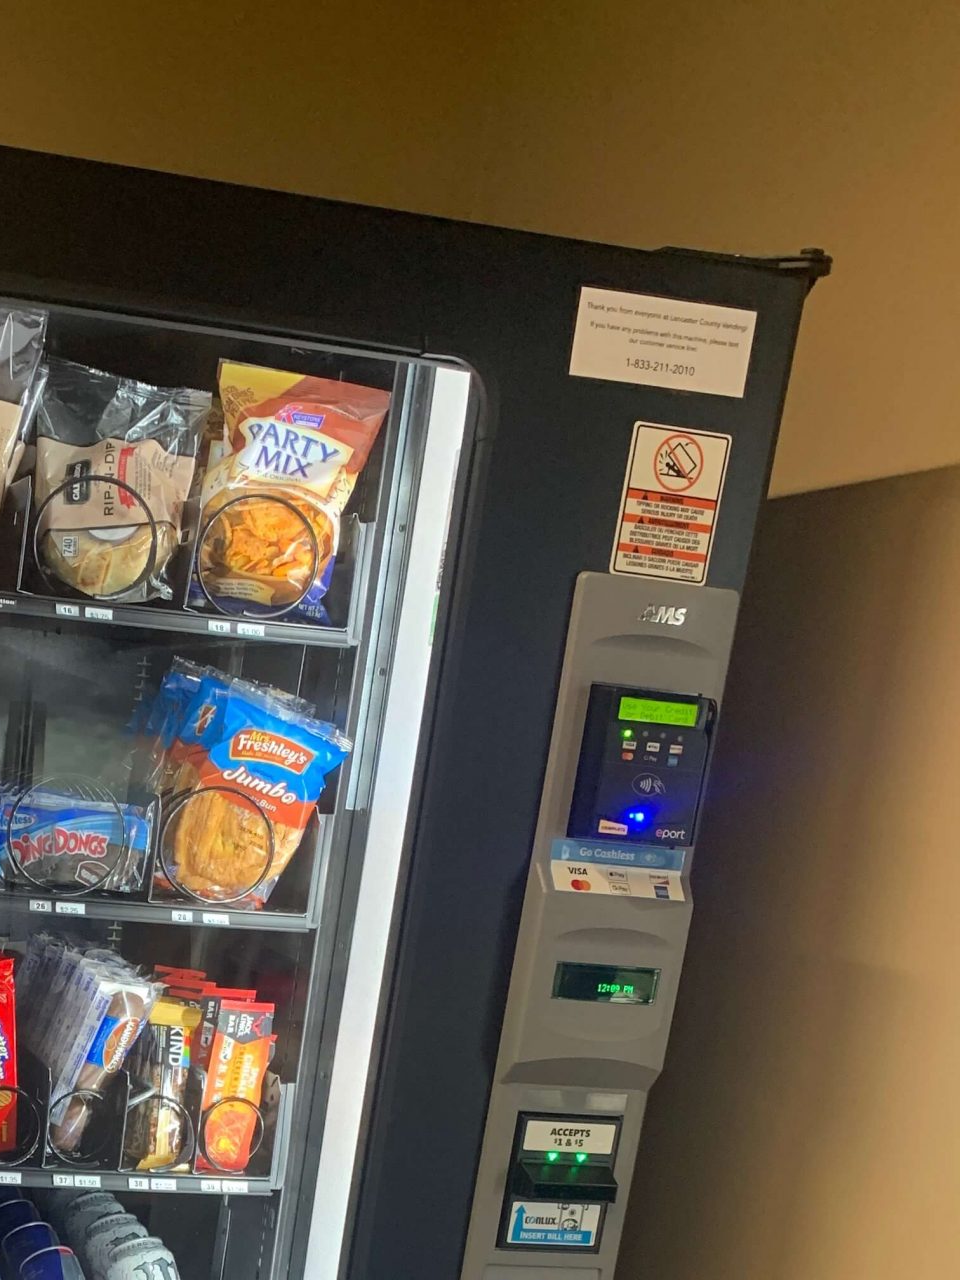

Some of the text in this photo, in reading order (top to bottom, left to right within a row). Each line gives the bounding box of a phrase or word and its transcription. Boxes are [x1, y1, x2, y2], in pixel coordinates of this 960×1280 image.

[588, 301, 604, 311] Thank
[606, 305, 617, 314] you
[619, 306, 634, 315] from
[700, 318, 721, 329] County
[607, 322, 620, 332] have
[626, 358, 696, 376] 1-833-211-2010
[248, 423, 339, 463] PARTY
[255, 446, 312, 478] MIX
[64, 538, 73, 556] 740
[250, 732, 271, 744] Mrs.
[238, 734, 308, 766] Freshley's
[222, 766, 298, 805] Jumbo
[260, 800, 278, 813] Bun
[656, 828, 686, 840] eport
[53, 827, 110, 860] DONGS
[580, 847, 636, 861] Go Cashless
[568, 866, 588, 876] VISA
[597, 983, 634, 994] 12:09 PM
[206, 1002, 215, 1018] BAR
[227, 1014, 236, 1034] BAR
[244, 1016, 255, 1035] JACK
[168, 1026, 184, 1066] KIND
[550, 1128, 590, 1138] ACCEPTS
[554, 1138, 584, 1148] $1 & $5
[58, 1176, 68, 1184] 37
[520, 1231, 582, 1241] INSERT BILL HERE
